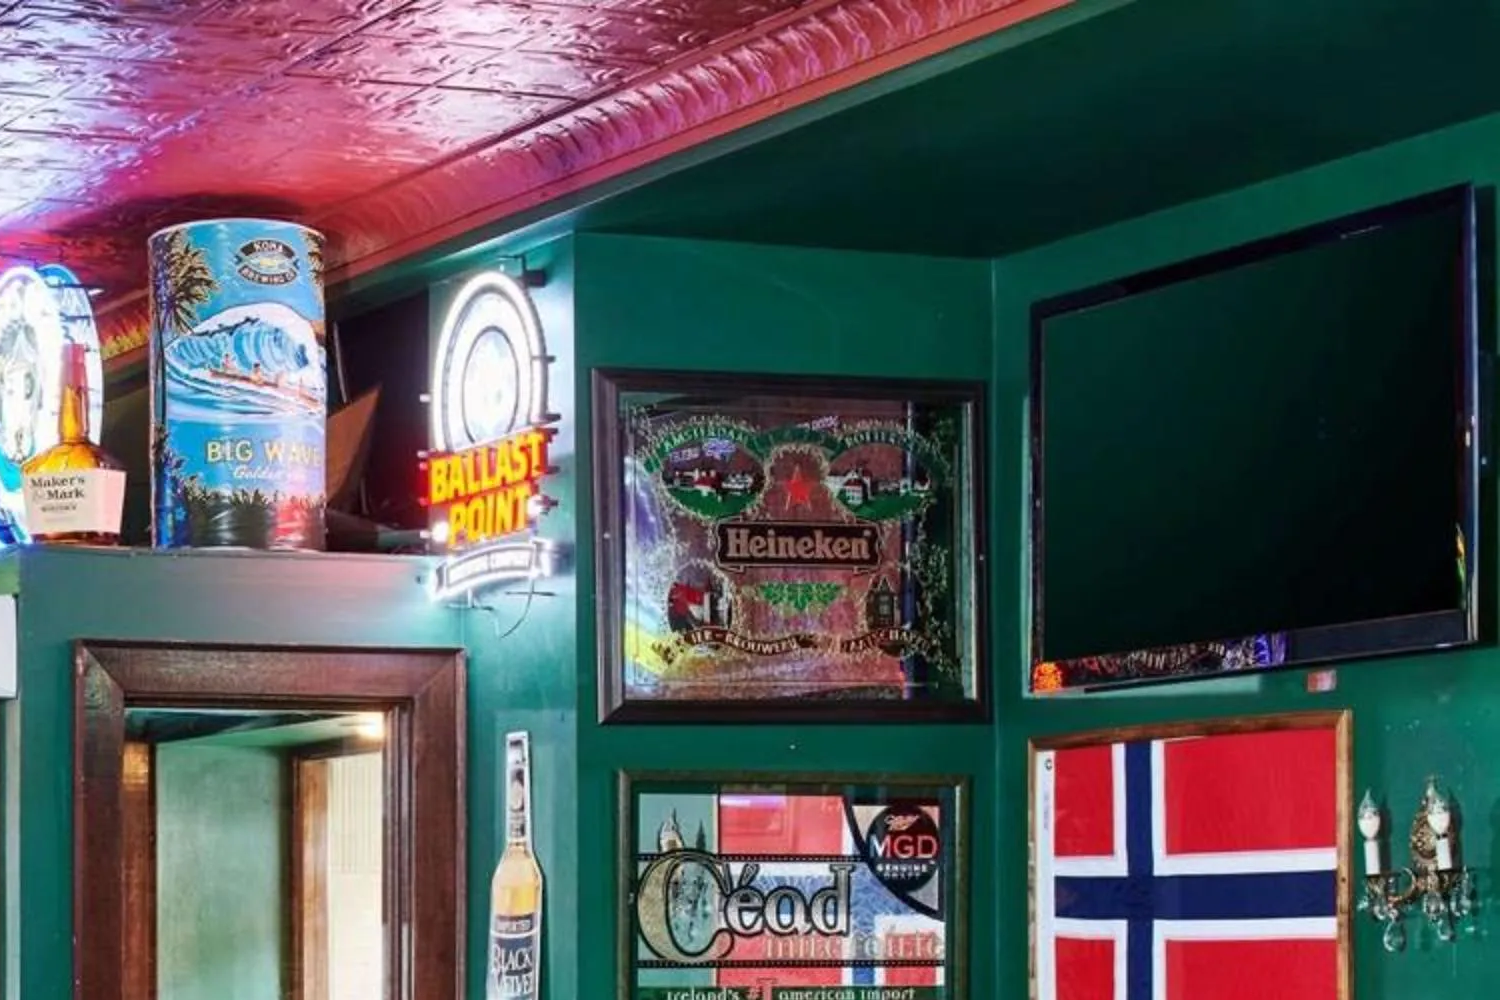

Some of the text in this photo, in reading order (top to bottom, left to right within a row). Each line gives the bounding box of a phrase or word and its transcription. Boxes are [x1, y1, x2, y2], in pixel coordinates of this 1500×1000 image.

[206, 440, 322, 467] BIG WAVE
[430, 430, 546, 505] BALLAST
[30, 476, 85, 488] Maker's
[47, 488, 85, 500] Mark
[448, 482, 532, 549] POINT
[726, 527, 872, 560] Heineken
[870, 834, 938, 859] MGD
[876, 863, 928, 873] GENUINE
[493, 945, 533, 970] BLACK
